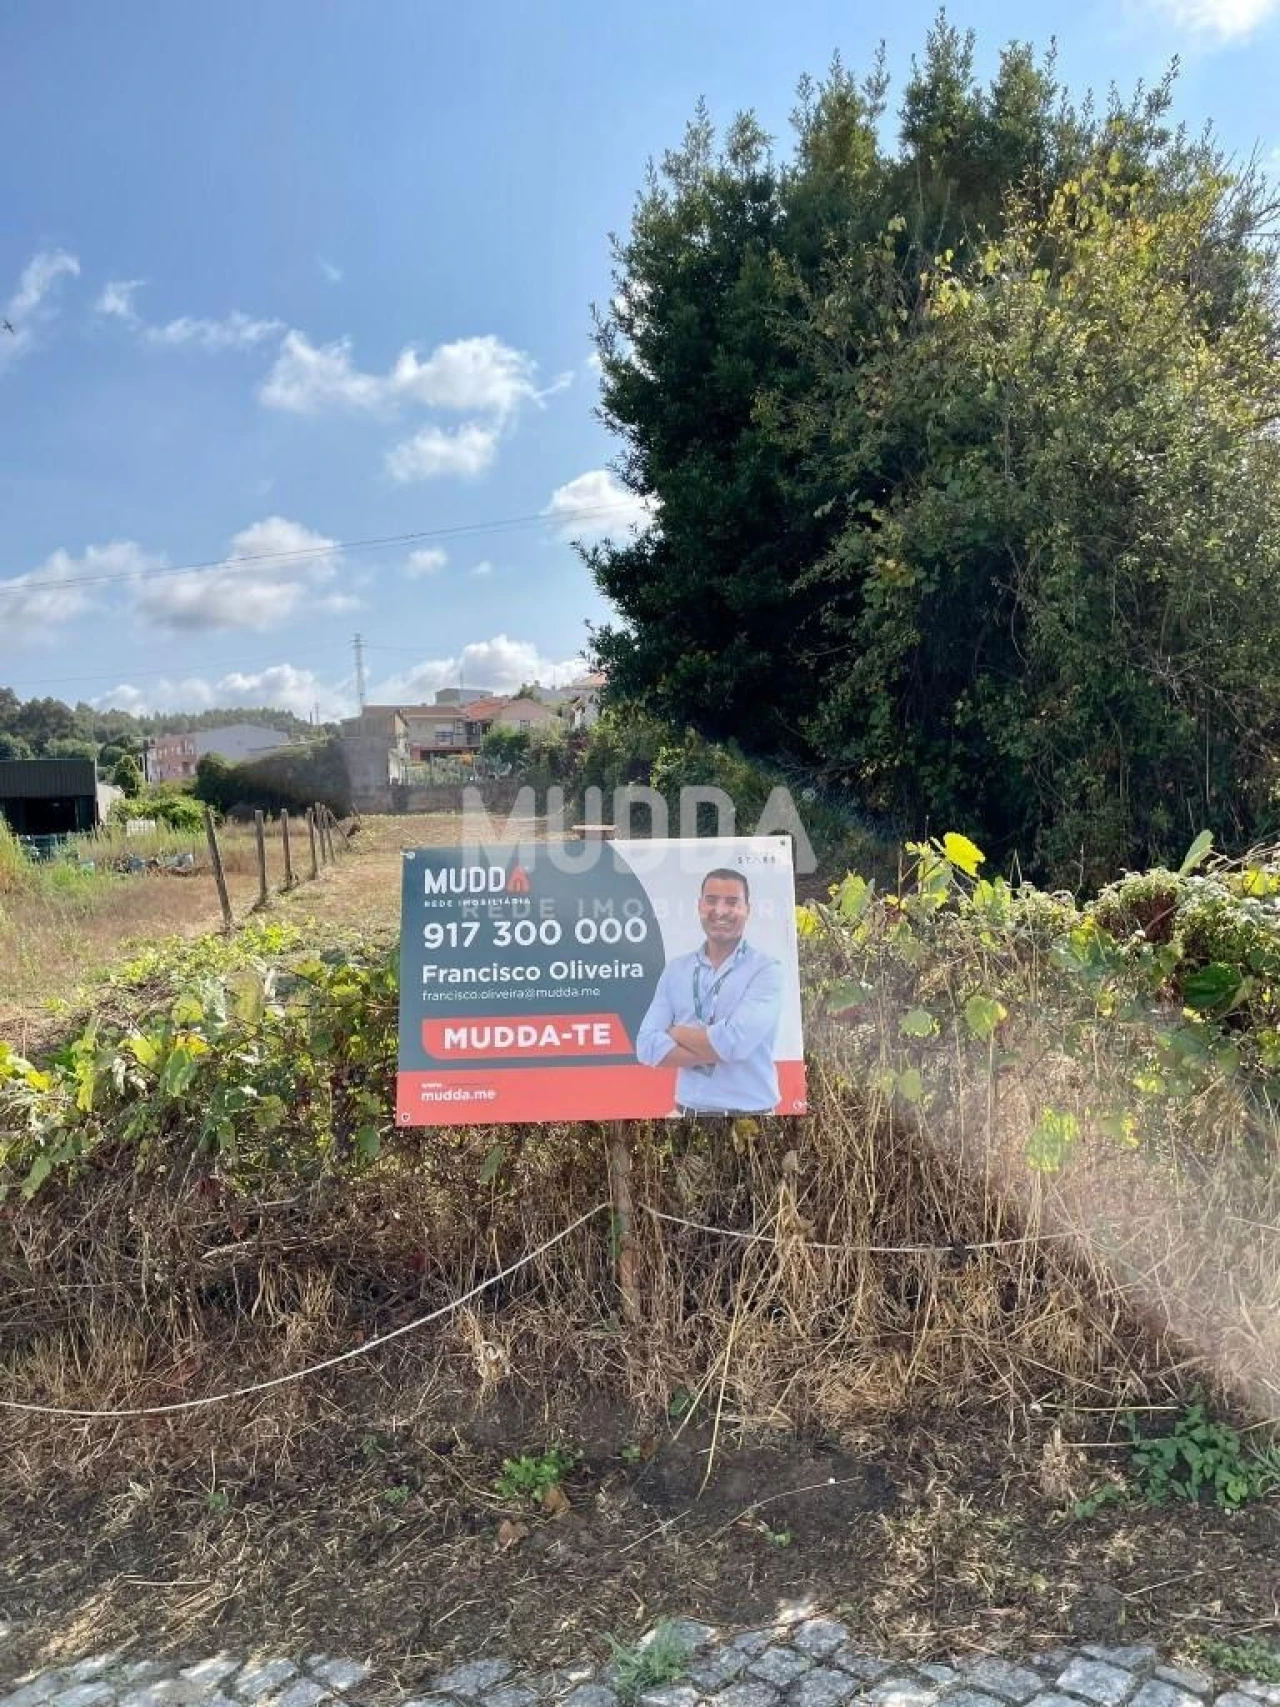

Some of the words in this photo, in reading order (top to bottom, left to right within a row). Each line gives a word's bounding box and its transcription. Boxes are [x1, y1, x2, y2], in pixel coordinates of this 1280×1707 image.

[424, 866, 531, 894] MUDDA
[424, 899, 453, 908] REDE
[422, 921, 481, 949] 917
[492, 919, 562, 946] 300
[574, 917, 648, 944] 000
[422, 963, 541, 984] Francisco
[549, 959, 645, 981] Oliveira
[422, 986, 601, 1001] francisco.oliveira@mudda.me
[444, 1023, 612, 1050] MUDDA-TE
[421, 1088, 497, 1101] mudda.me
